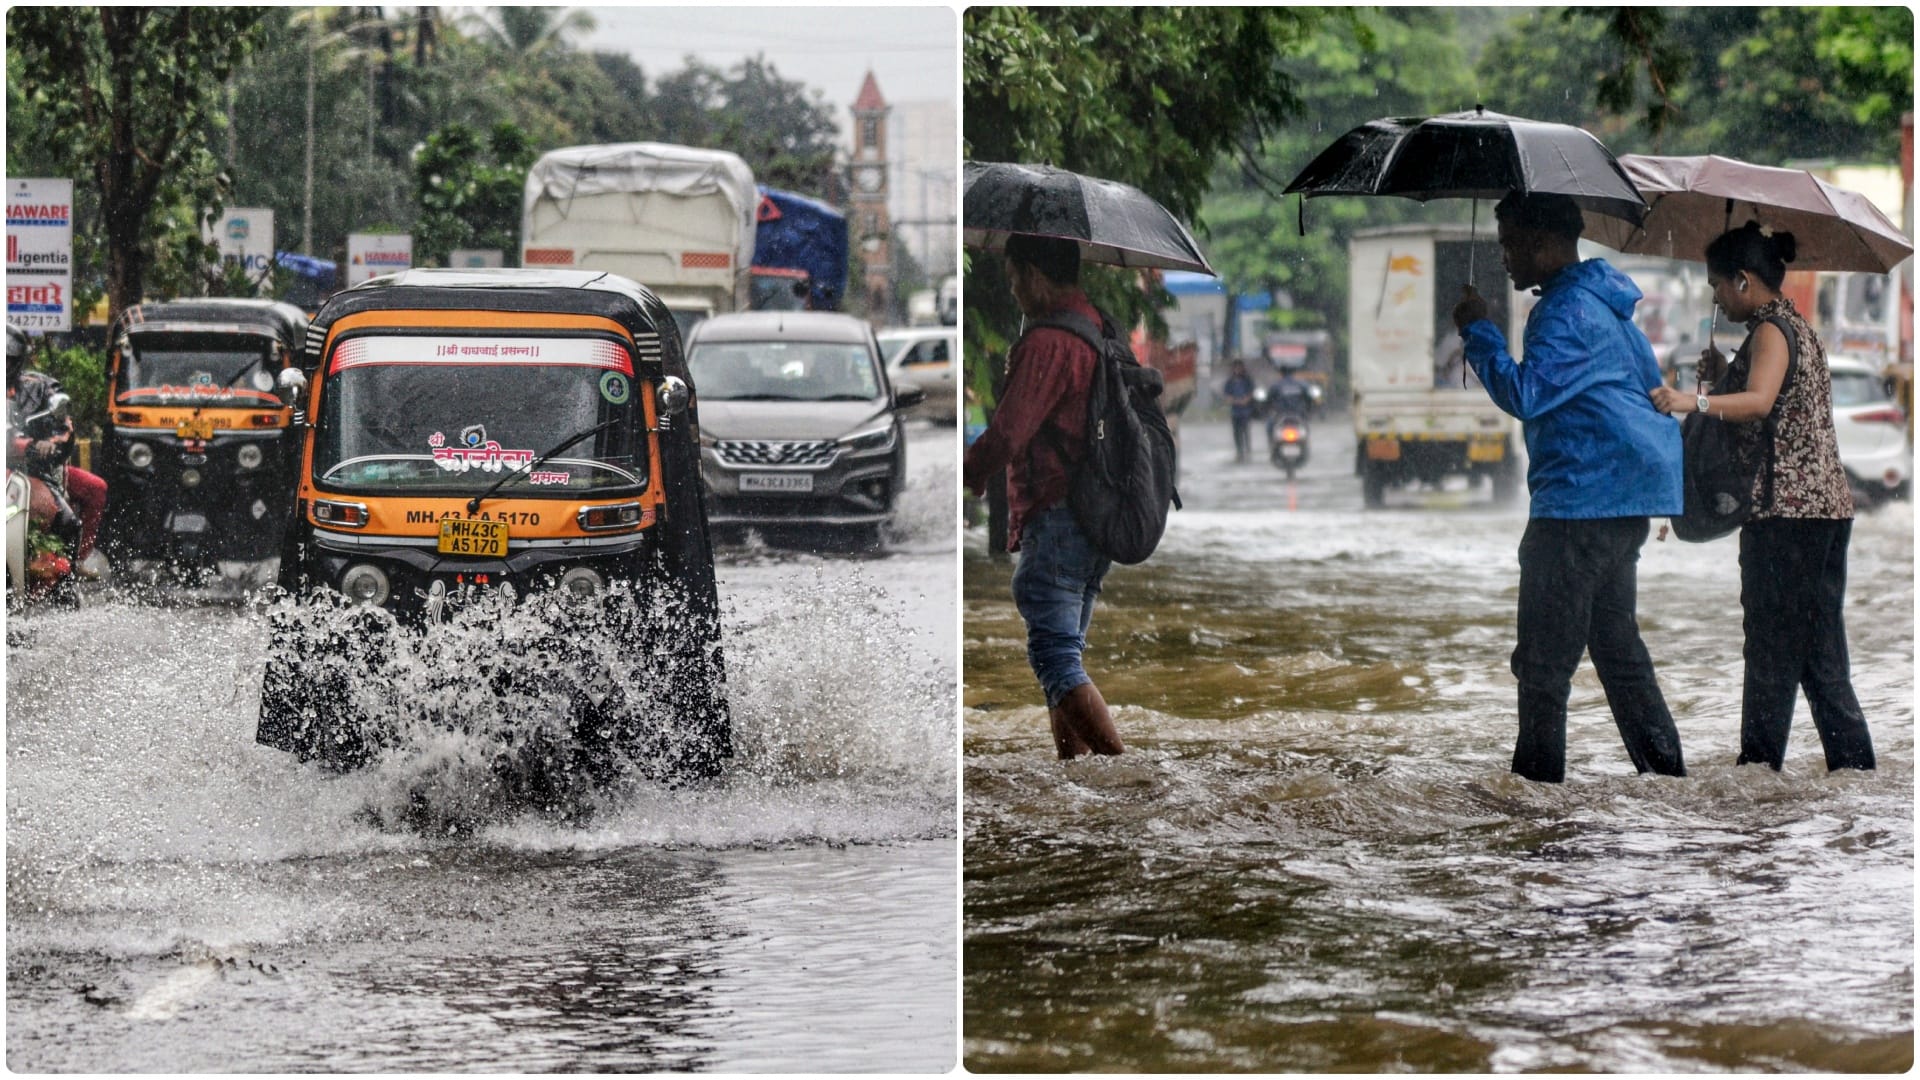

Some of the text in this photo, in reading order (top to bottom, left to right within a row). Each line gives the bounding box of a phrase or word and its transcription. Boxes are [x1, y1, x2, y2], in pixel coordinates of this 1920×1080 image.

[498, 512, 540, 526] 5170
[451, 522, 499, 538] MH43C
[451, 537, 499, 554] A5170
